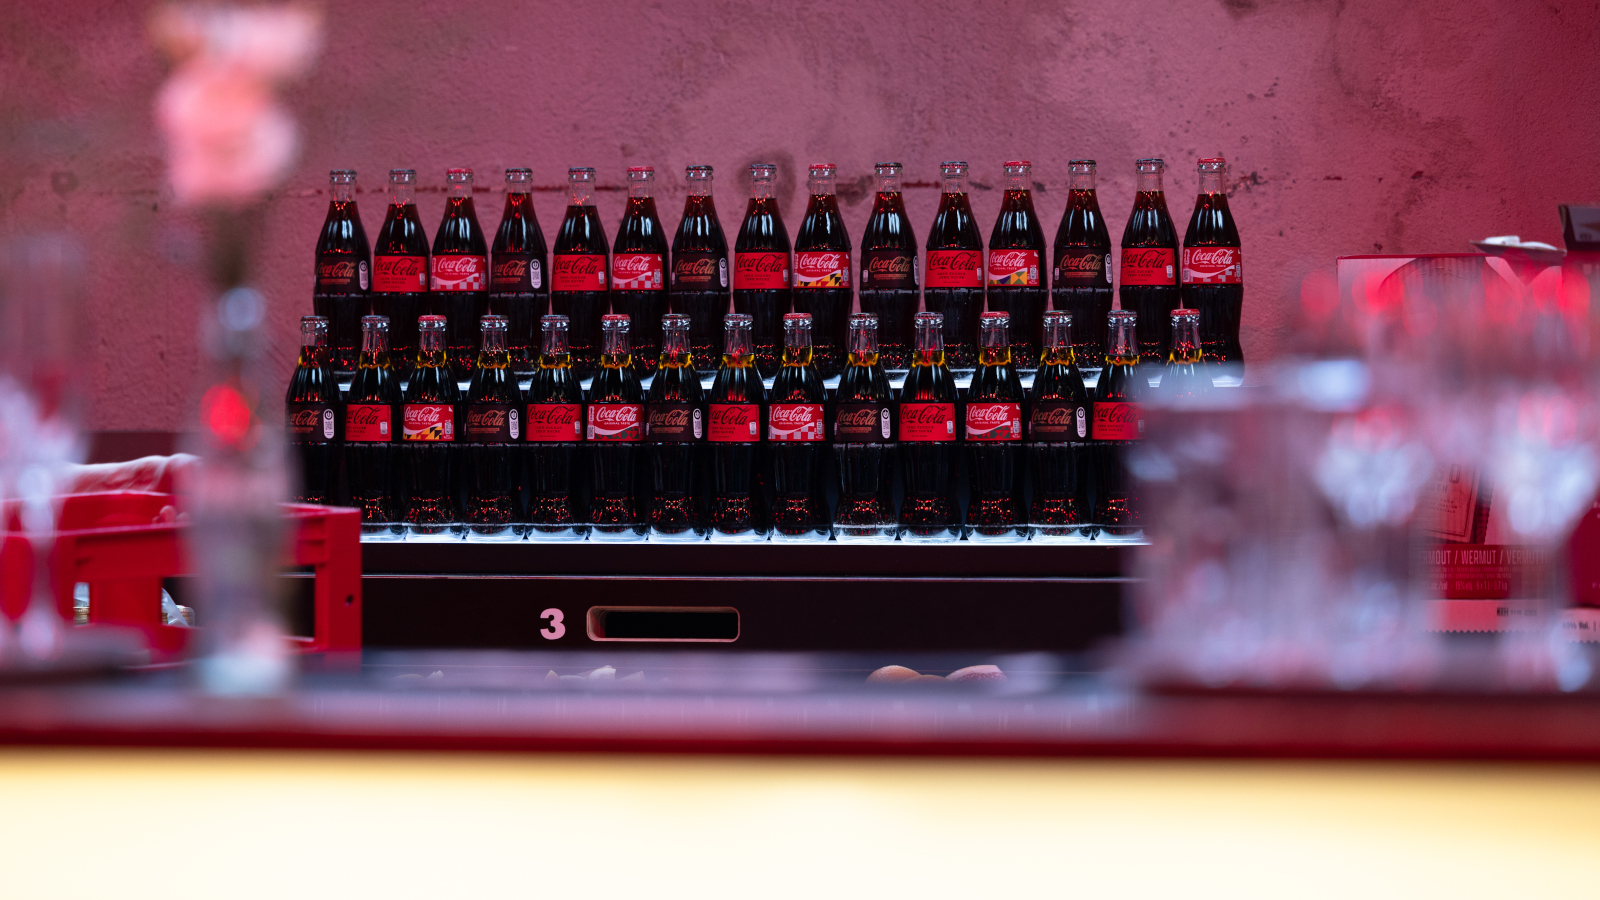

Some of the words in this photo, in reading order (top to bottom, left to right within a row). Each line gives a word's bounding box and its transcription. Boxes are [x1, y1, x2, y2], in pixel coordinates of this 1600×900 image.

[614, 255, 651, 270] Coca-Cola
[736, 254, 784, 272] Coca-Cola
[800, 253, 840, 269] Coca-Cola
[869, 255, 911, 272] Coca-Cola
[929, 252, 977, 270] Coca-Cola
[989, 251, 1027, 266] Coca-Cola
[1060, 253, 1103, 270] Coca-Cola
[1122, 250, 1168, 268] Coca-Cola
[1192, 248, 1234, 264] Coca-Cola
[374, 257, 421, 276] Coca-Cola
[438, 258, 478, 272] Coca-Cola
[553, 256, 600, 274] Coca-Cola
[675, 258, 717, 274] Coca-Cola
[404, 406, 442, 422] Coca-Cola
[467, 410, 507, 426] Coca-Cola
[528, 405, 575, 424] Coca-Cola
[596, 406, 638, 421] Coca-Cola
[650, 409, 690, 425] Coca-Cola
[773, 405, 814, 421] Coca-Cola
[837, 408, 878, 425] Coca-Cola
[901, 405, 948, 424] Coca-Cola
[969, 405, 1009, 421] Coca-Cola
[1031, 408, 1074, 424] Coca-Cola
[1460, 549, 1496, 564] WERMUT
[540, 607, 566, 640] 3
